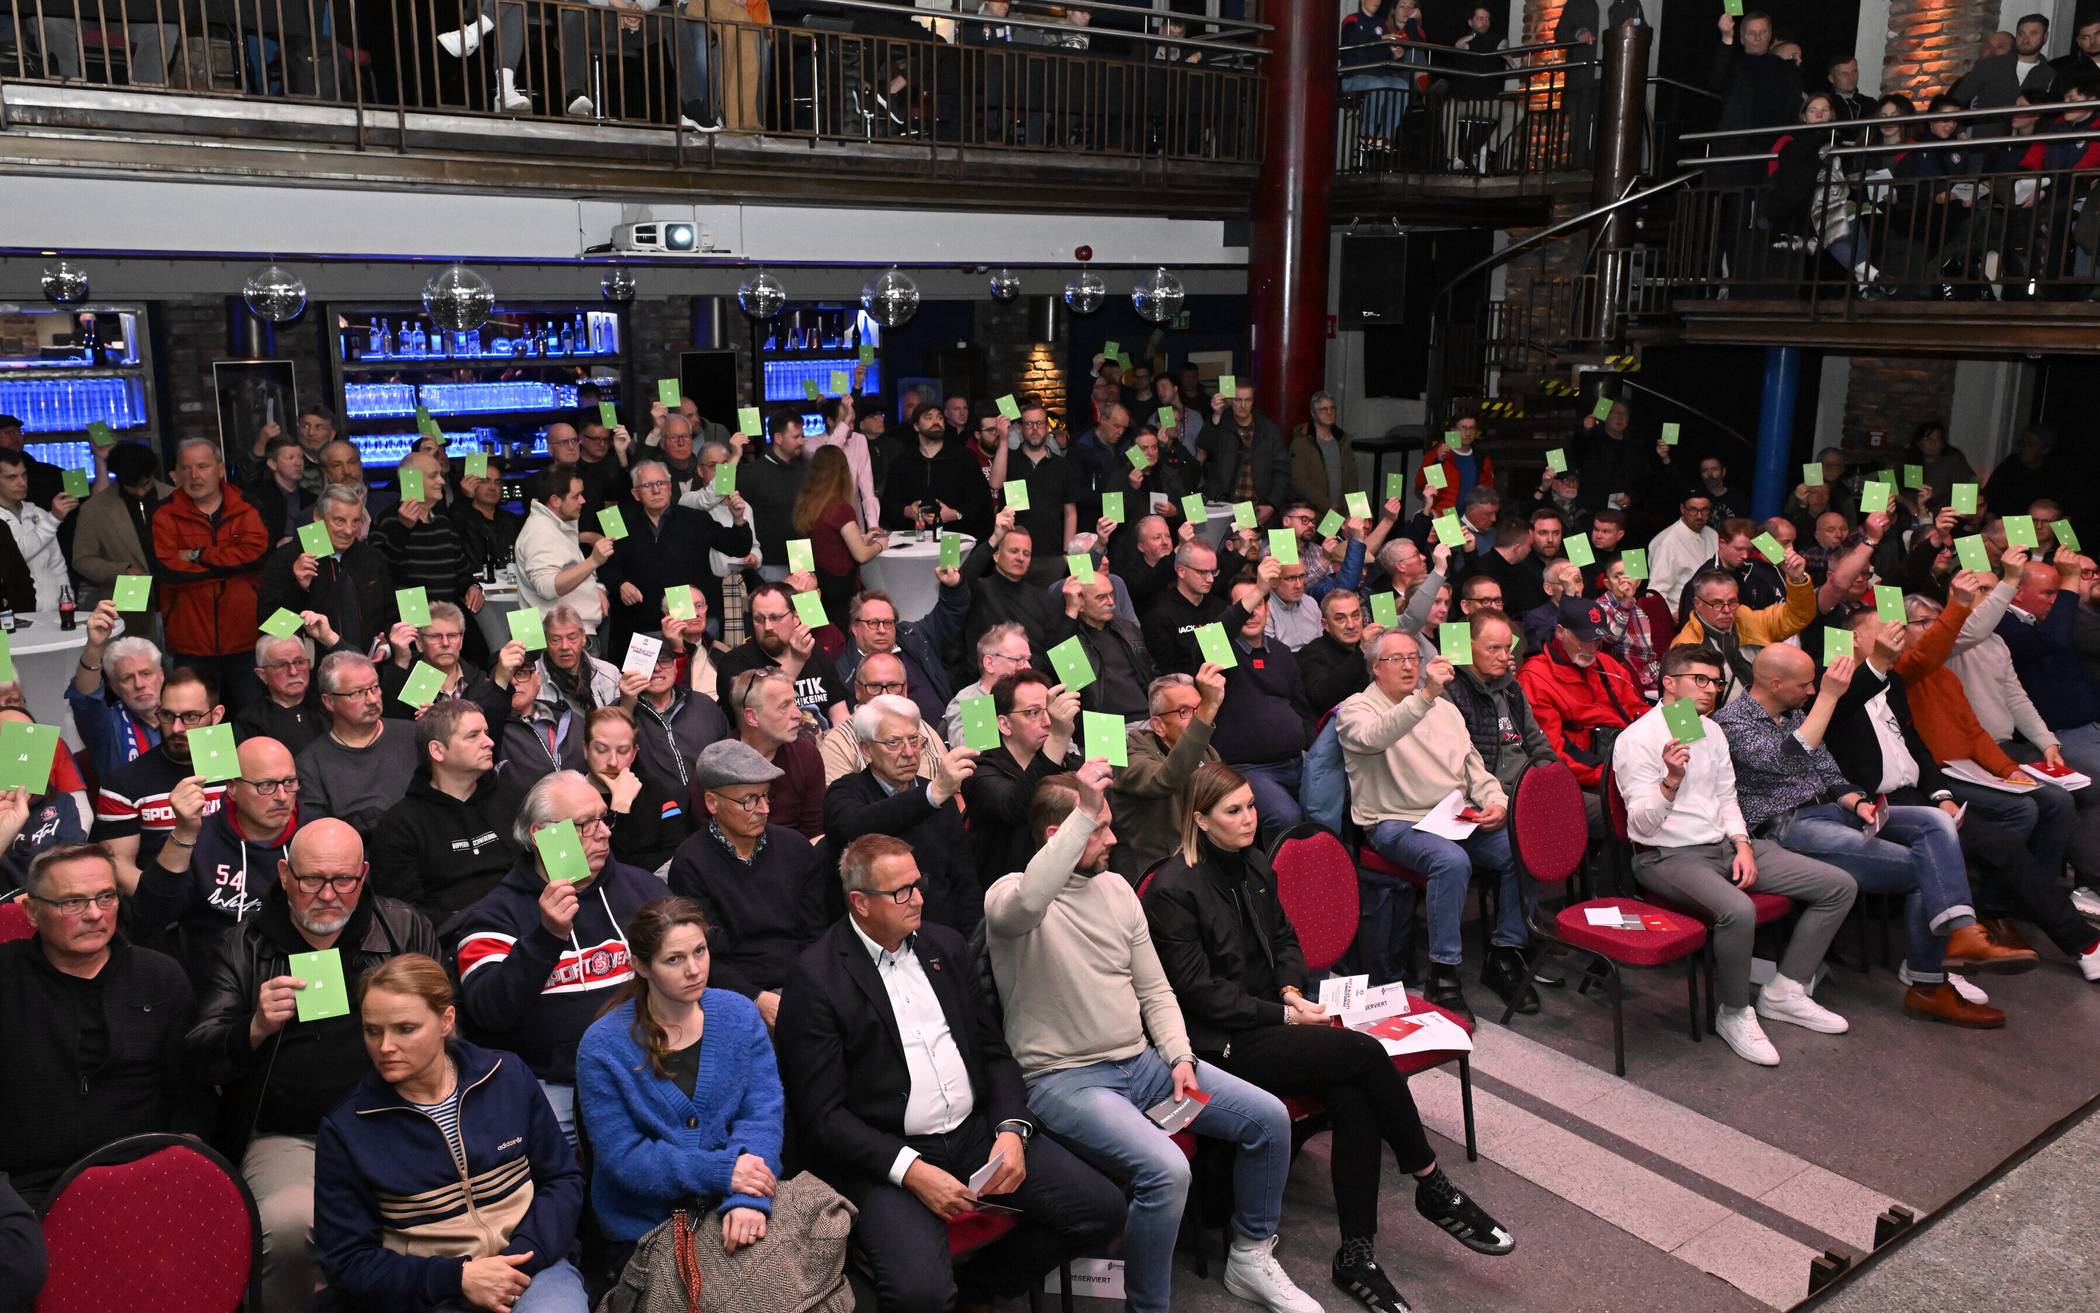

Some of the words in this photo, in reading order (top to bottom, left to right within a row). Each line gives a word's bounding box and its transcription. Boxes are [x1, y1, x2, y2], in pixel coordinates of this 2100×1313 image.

[794, 677, 827, 697] TIK
[803, 694, 828, 705] KEINE
[141, 806, 176, 821] SPO
[216, 864, 243, 891] 54
[315, 980, 323, 989] JA
